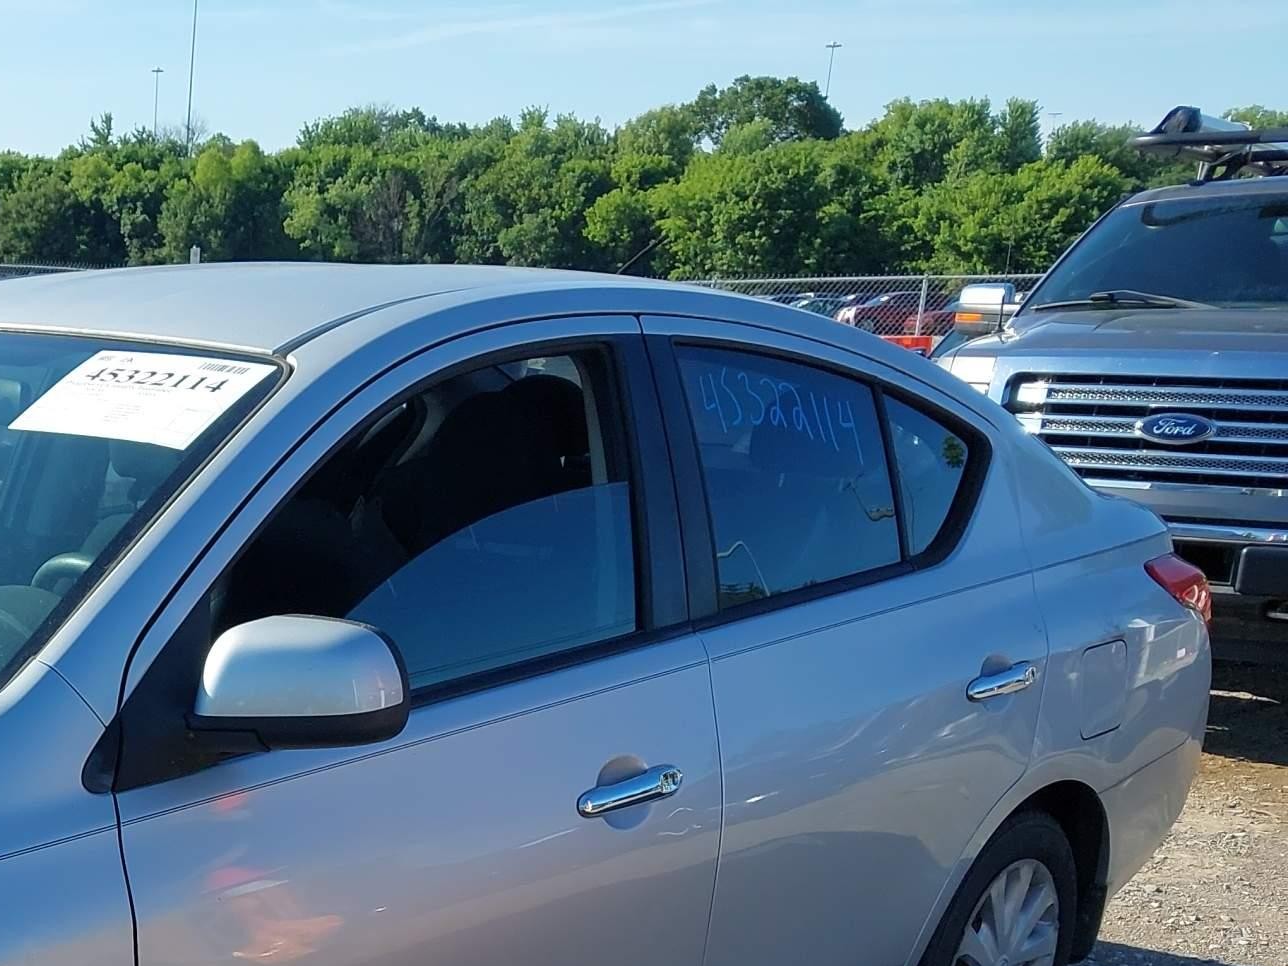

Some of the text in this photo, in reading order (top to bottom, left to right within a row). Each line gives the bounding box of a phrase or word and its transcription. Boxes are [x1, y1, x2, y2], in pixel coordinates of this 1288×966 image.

[84, 366, 230, 393] 45322114
[699, 366, 864, 465] 45322114
[1152, 417, 1198, 436] Ford
